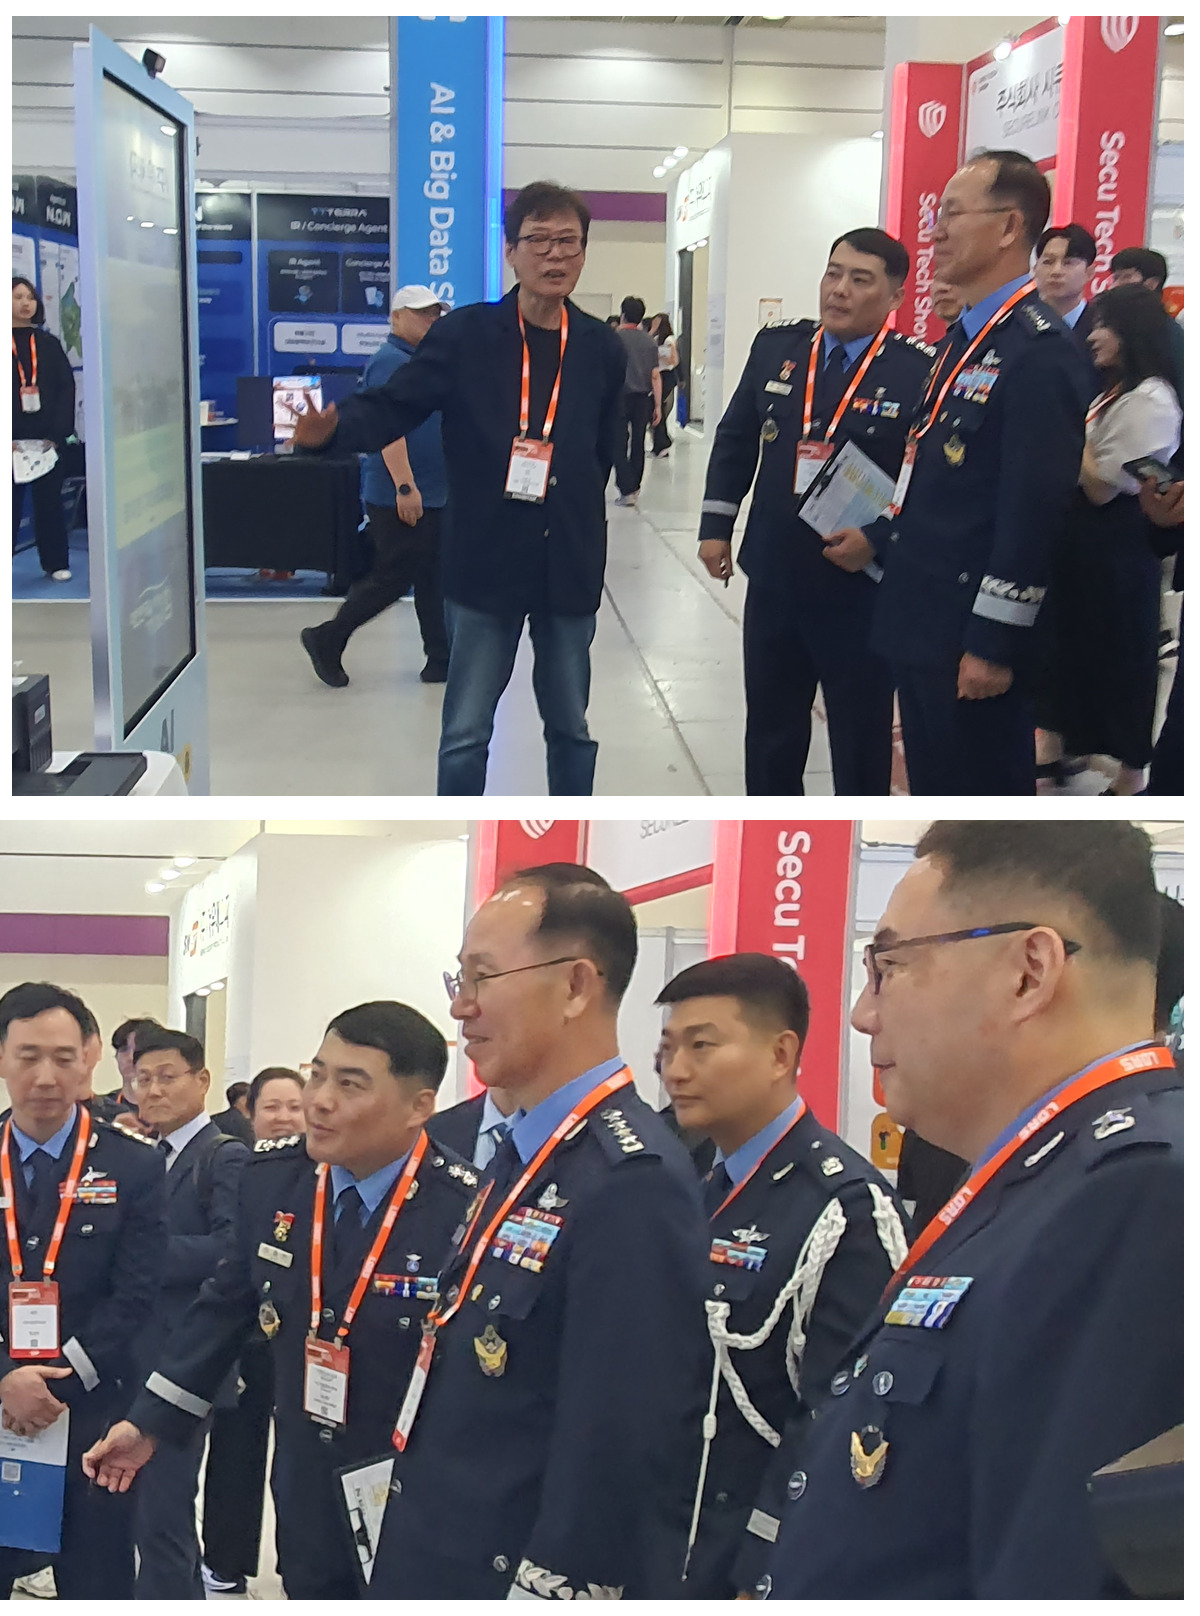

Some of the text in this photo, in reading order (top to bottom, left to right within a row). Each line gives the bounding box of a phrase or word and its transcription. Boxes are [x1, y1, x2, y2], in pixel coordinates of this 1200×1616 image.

[429, 82, 456, 115] AI
[429, 121, 456, 143] &
[423, 151, 458, 200] Big
[1096, 130, 1126, 202] Secu
[307, 221, 357, 234] Concierge
[358, 222, 388, 234] Agent
[429, 207, 455, 276] Data
[1093, 204, 1120, 272] Tech
[913, 192, 938, 339] Secu Tech Sho
[771, 829, 812, 969] Secu T
[1119, 1051, 1161, 1072] LORS
[1017, 1101, 1060, 1141] LORS
[938, 1186, 974, 1227] LORS
